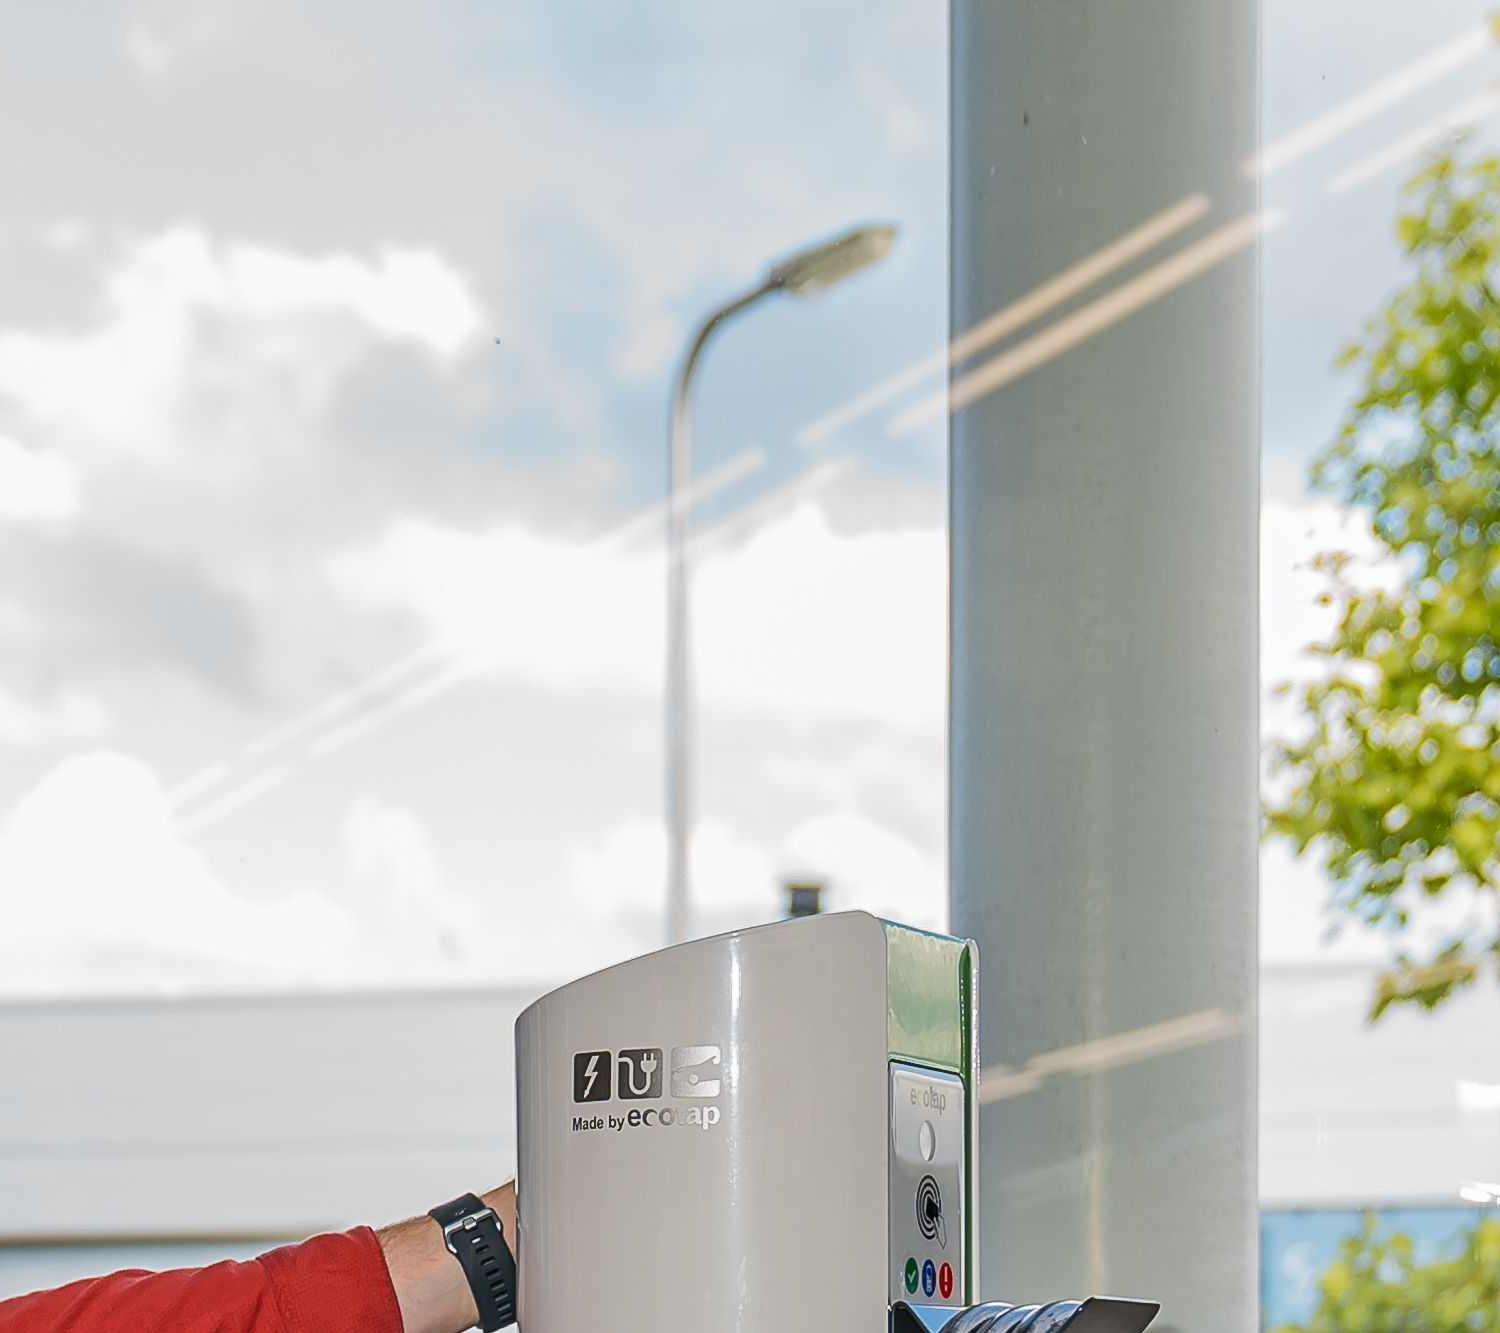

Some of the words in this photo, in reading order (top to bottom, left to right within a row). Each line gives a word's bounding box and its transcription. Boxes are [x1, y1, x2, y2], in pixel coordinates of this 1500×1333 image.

[572, 1116, 604, 1132] Made
[608, 1114, 625, 1132] by
[627, 1103, 721, 1130] ecotap
